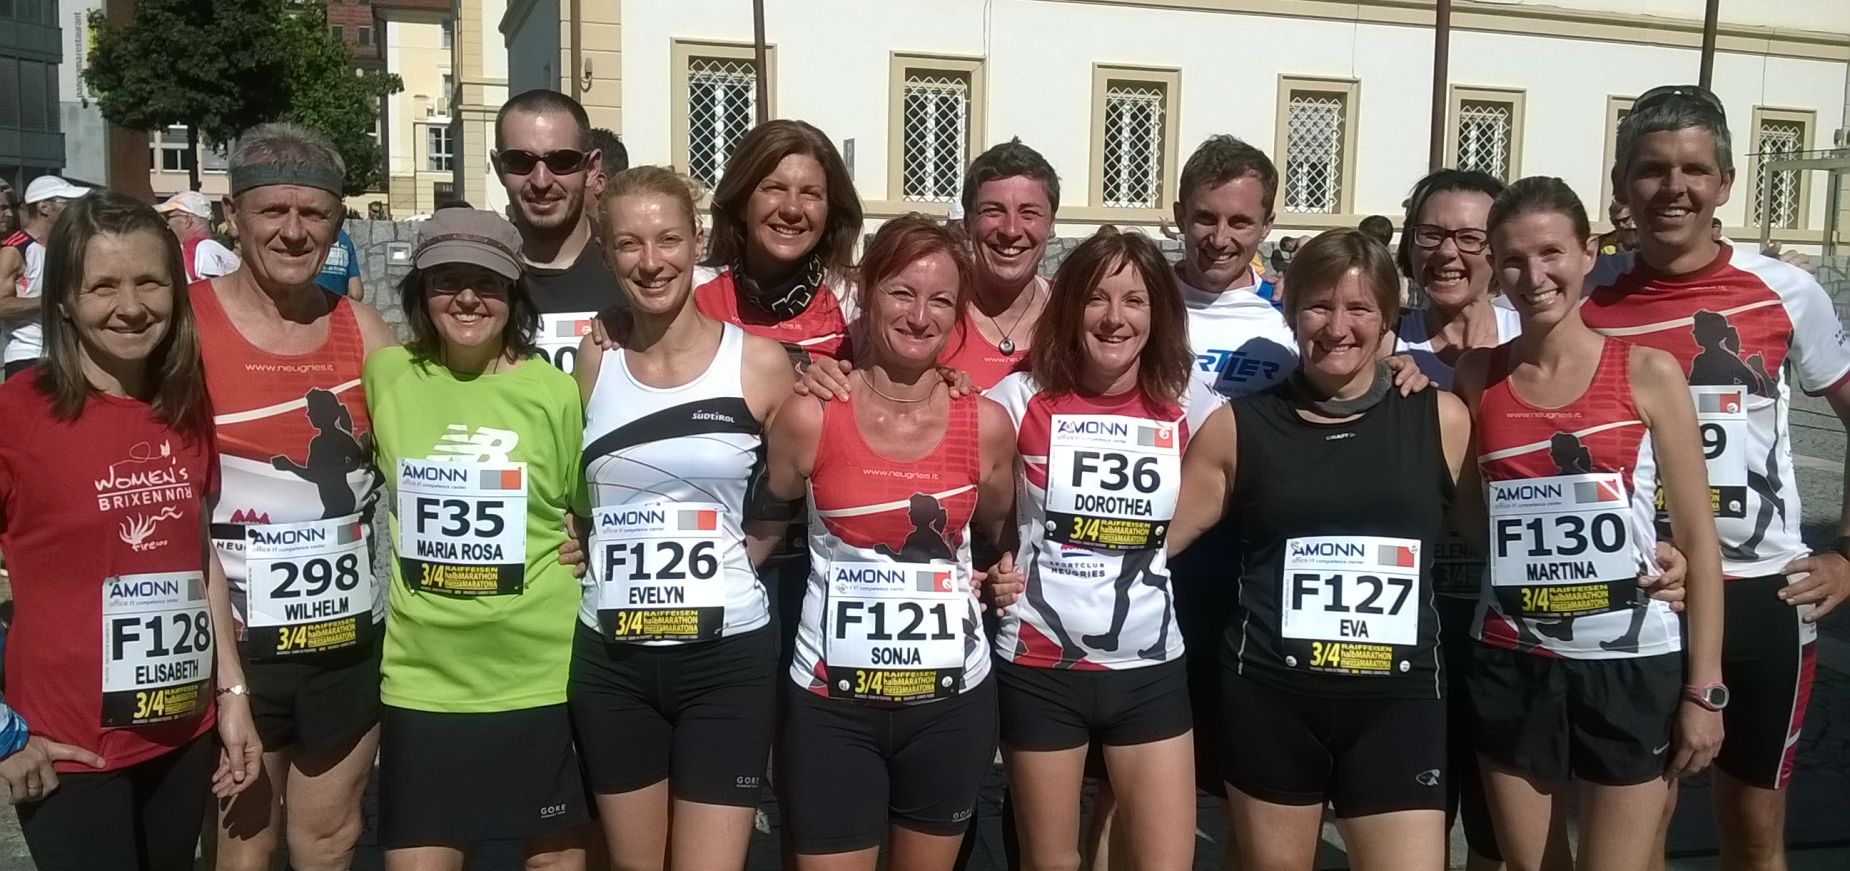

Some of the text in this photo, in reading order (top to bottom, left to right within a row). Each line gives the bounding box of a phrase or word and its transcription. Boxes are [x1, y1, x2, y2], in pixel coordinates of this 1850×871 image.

[402, 465, 467, 482] AMONN
[1072, 450, 1161, 494] F36
[98, 489, 162, 511] BRIXEN
[1074, 494, 1152, 516] DOROTHEA
[1495, 484, 1562, 502] AMONN
[416, 497, 505, 538] F35
[602, 510, 665, 527] AMONN
[1069, 516, 1100, 541] 3/4
[216, 540, 246, 551] NEU
[252, 528, 326, 545] AMONN
[1497, 513, 1626, 558] F130
[417, 539, 504, 560] MARIA ROSA
[605, 541, 718, 582] F126
[270, 553, 359, 599] 298
[421, 563, 444, 588] 3/4
[836, 568, 905, 583] AMONN
[1051, 567, 1106, 579] NEUGRIES
[1527, 561, 1598, 581] MARTINA
[110, 580, 179, 598] AMONN
[629, 586, 685, 605] EVELYN
[1292, 573, 1413, 616] F127
[1520, 587, 1549, 612] 3/4
[285, 597, 349, 621] WILHELM
[836, 600, 955, 641] F121
[112, 610, 210, 661] F128
[615, 611, 643, 636] 3/4
[1340, 619, 1369, 638] EVA
[276, 626, 307, 651] 3/4
[871, 647, 922, 665] SONJA
[1310, 641, 1340, 667] 3/4
[136, 659, 199, 685] ELISABETH
[854, 670, 883, 695] 3/4
[132, 689, 165, 719] 3/4
[540, 804, 567, 815] GORE
